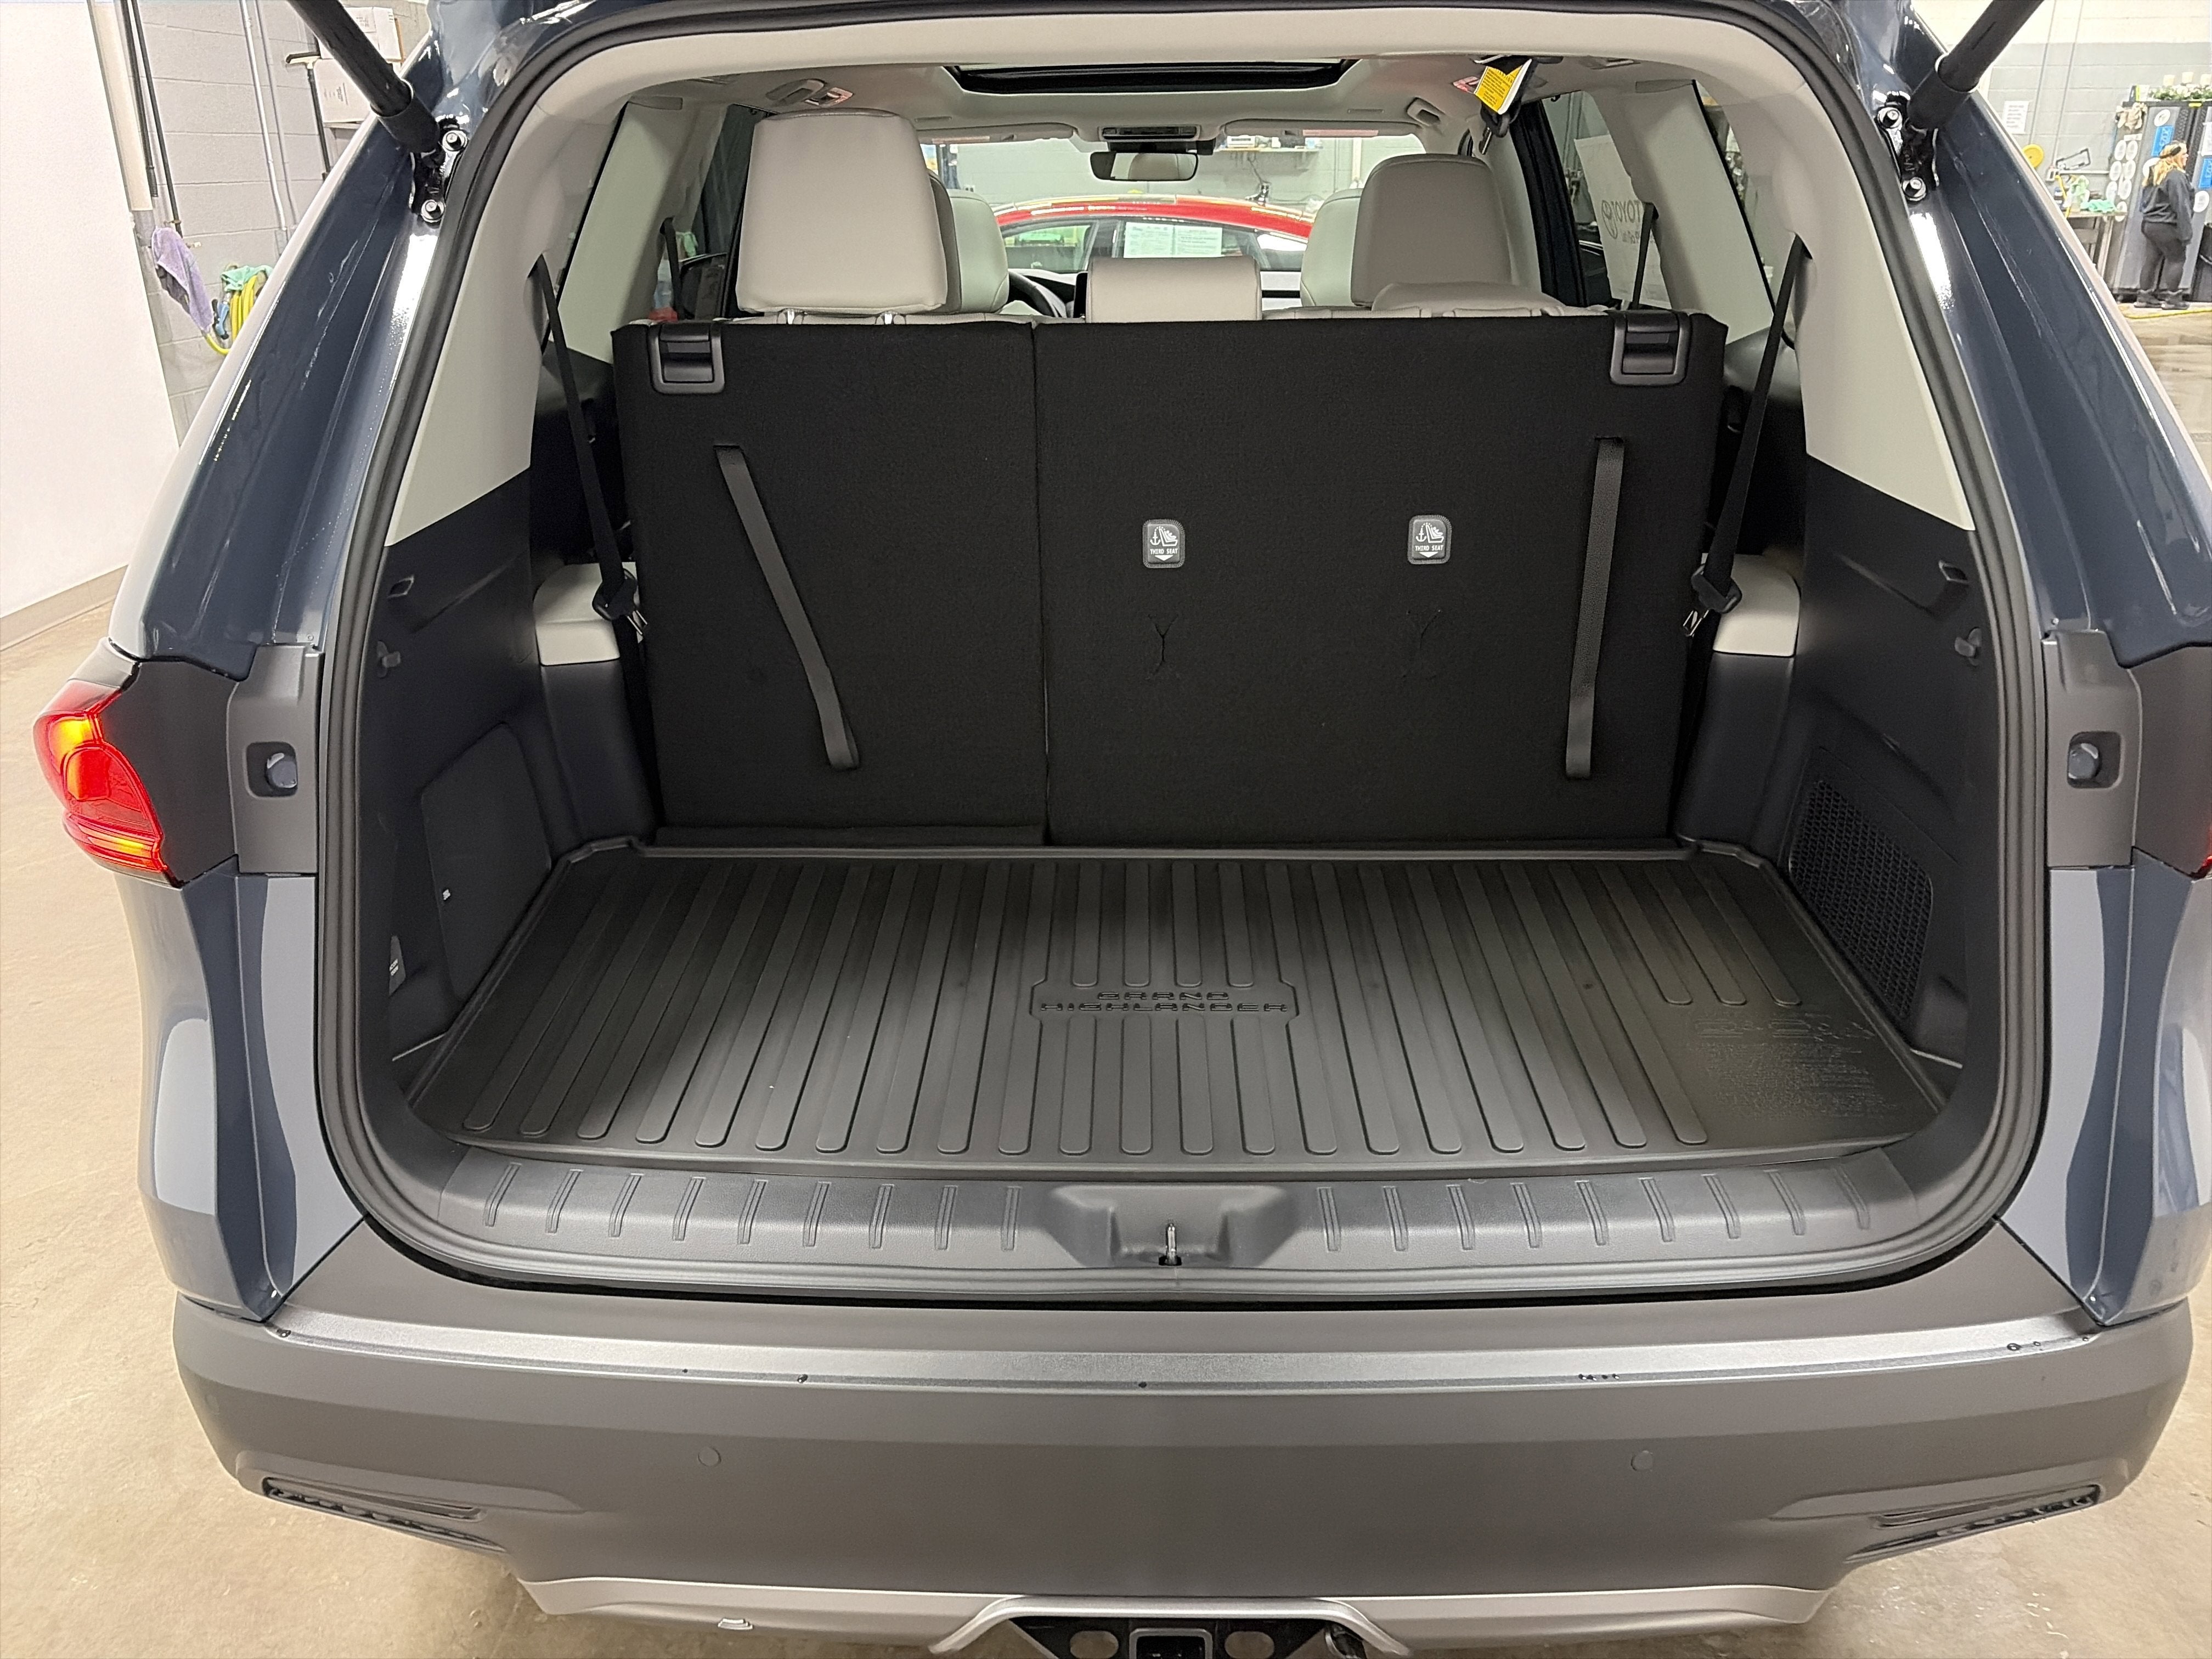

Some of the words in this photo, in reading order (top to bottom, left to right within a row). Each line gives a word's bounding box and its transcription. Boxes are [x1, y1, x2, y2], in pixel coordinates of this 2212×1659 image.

[1611, 199, 1641, 223] TOYOT
[1097, 992, 1229, 1000] GRAND
[1040, 1003, 1288, 1012] HIGHLANDER
